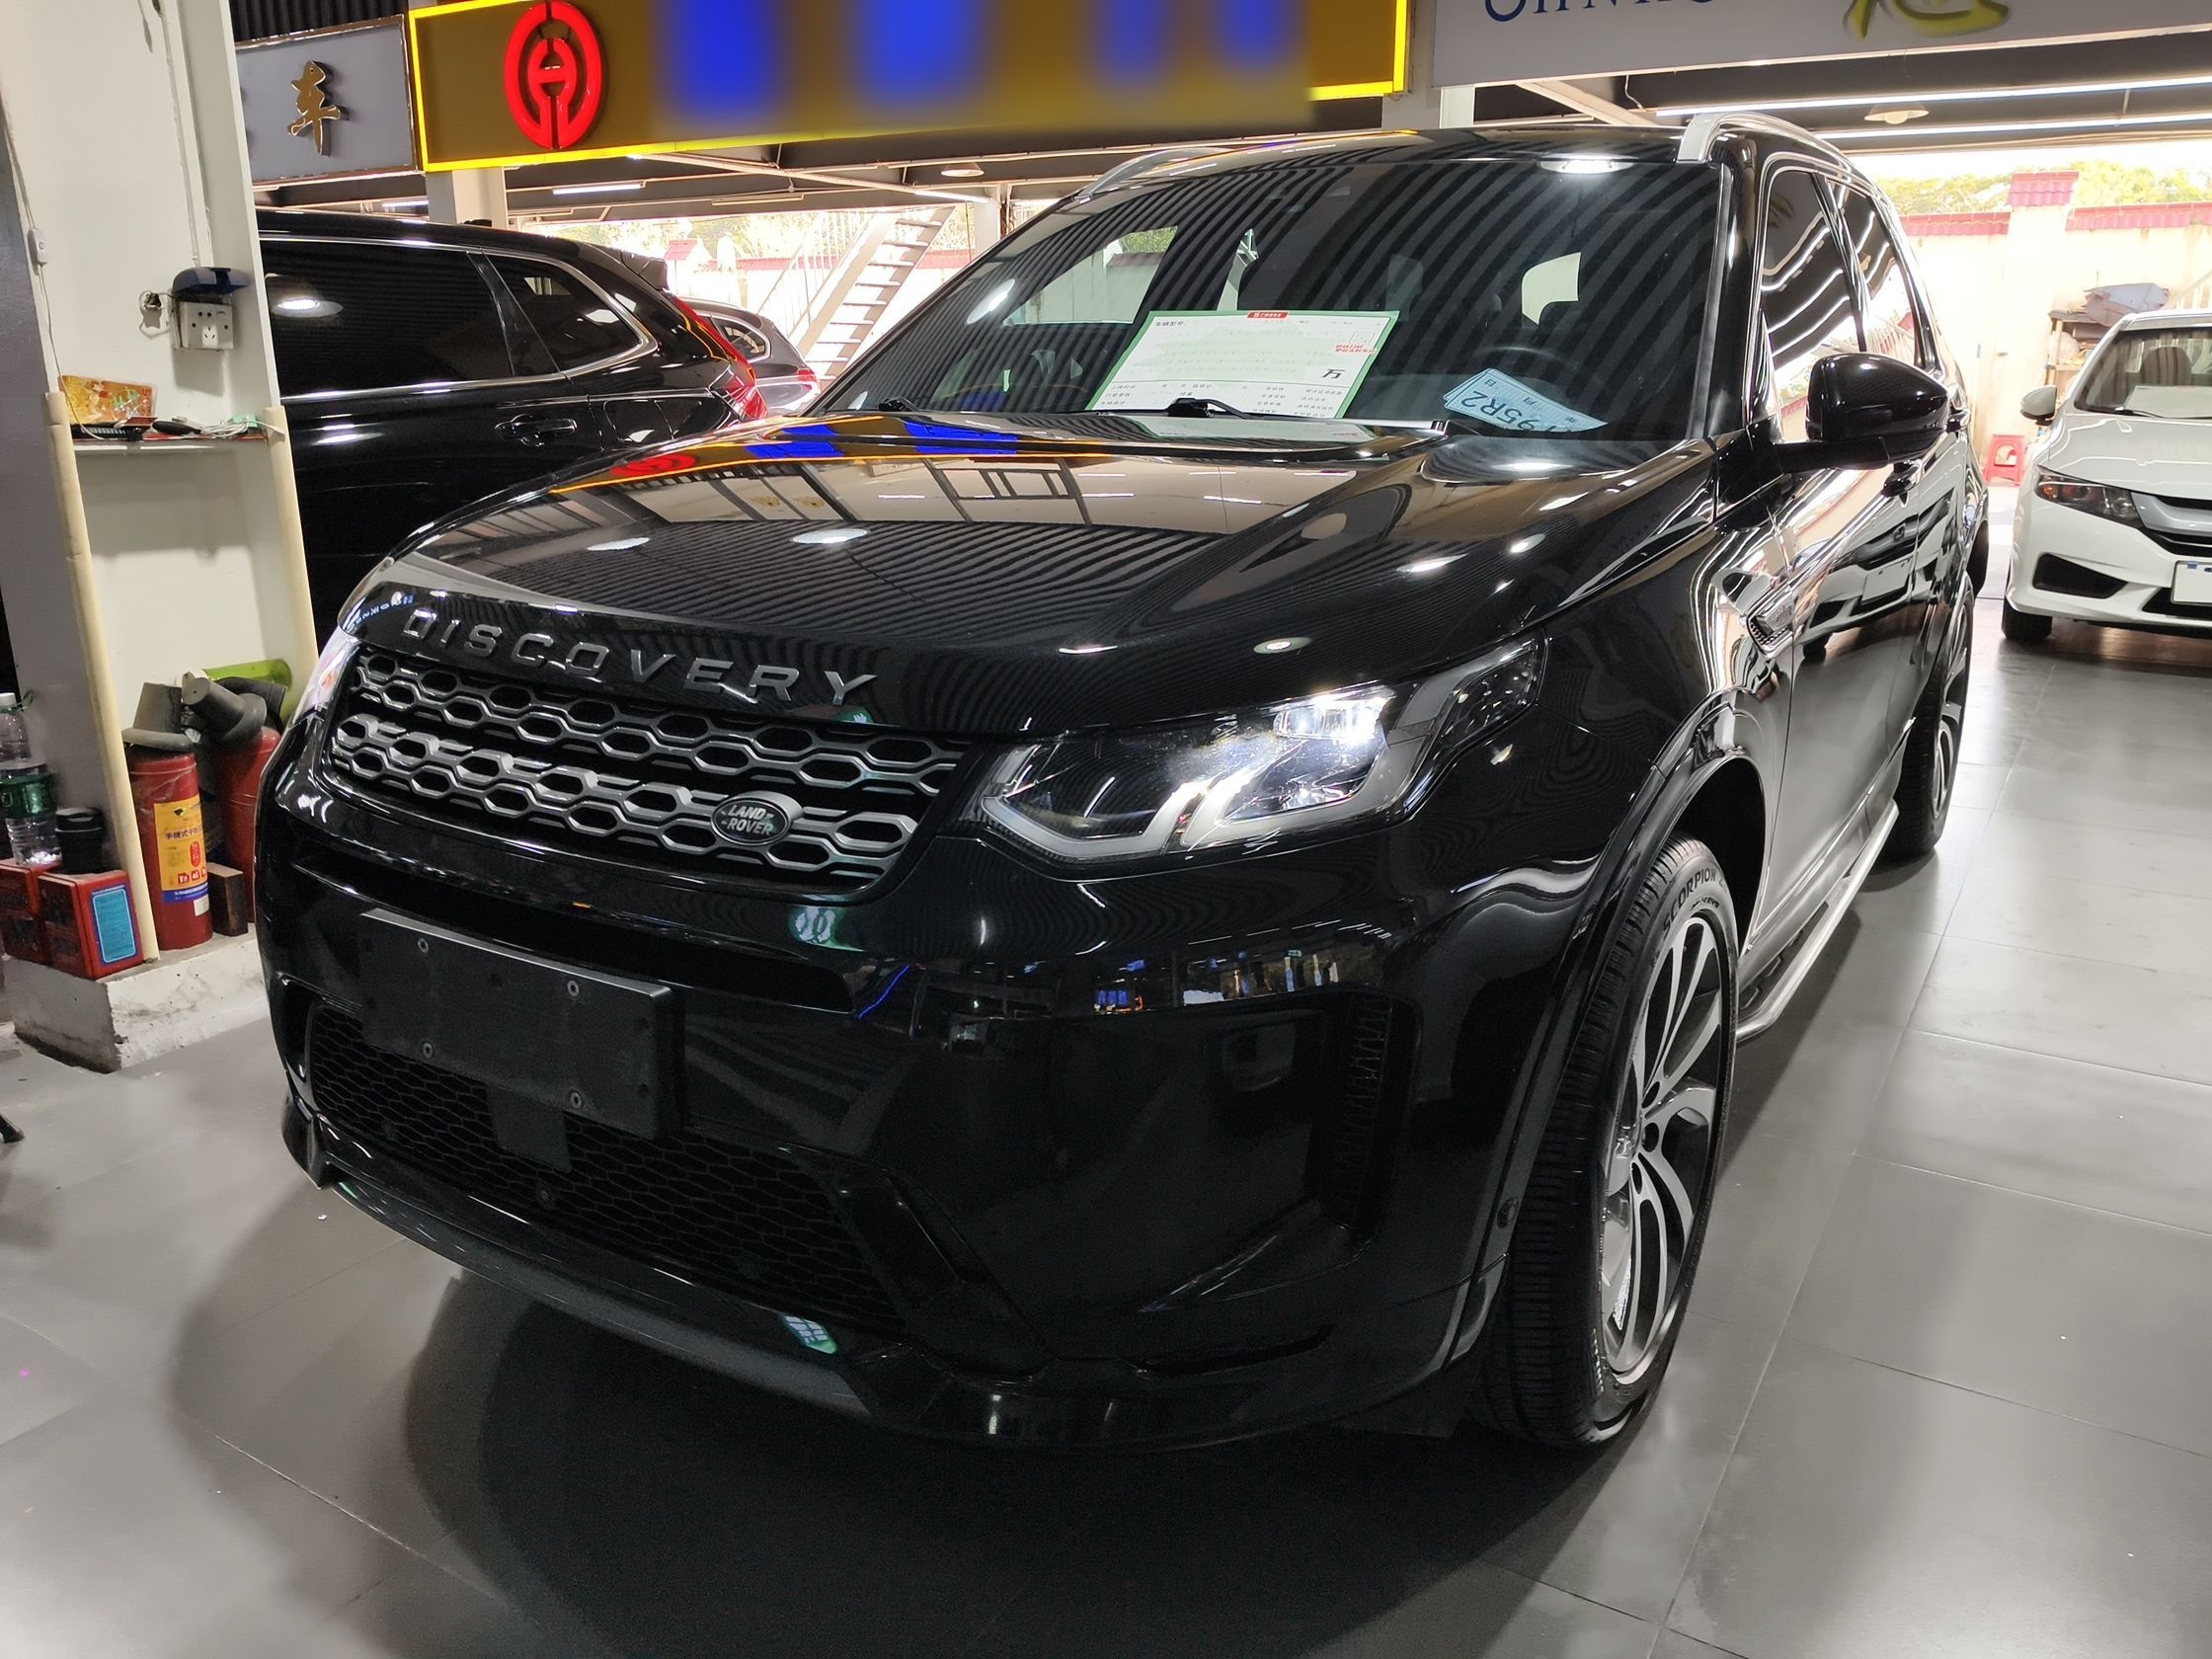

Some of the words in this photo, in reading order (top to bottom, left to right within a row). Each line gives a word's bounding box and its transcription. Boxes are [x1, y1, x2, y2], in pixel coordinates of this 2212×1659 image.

[1322, 368, 1345, 380] 万
[401, 608, 878, 706] DISCOVERY
[728, 804, 767, 821] LAND
[727, 818, 774, 836] ROVER
[1663, 867, 1717, 941] SCORPION
